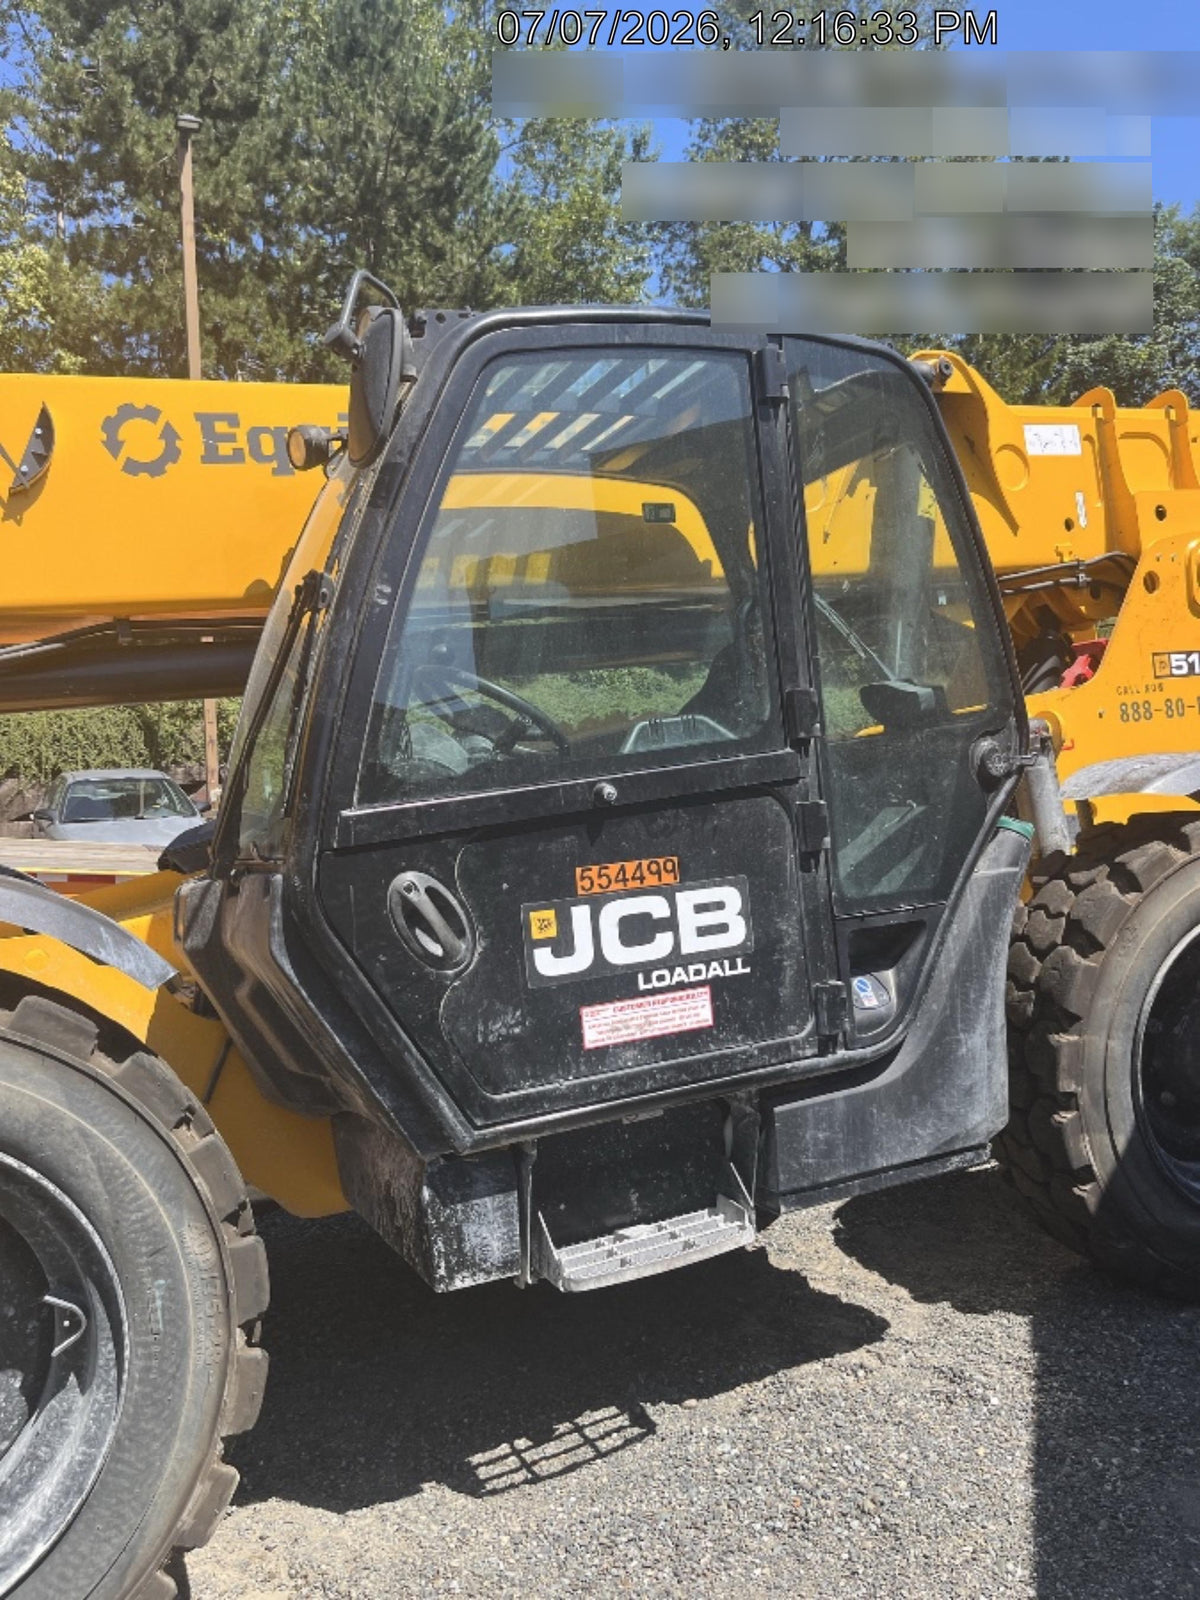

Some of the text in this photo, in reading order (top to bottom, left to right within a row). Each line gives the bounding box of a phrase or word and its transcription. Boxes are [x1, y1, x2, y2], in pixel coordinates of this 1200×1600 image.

[193, 412, 348, 476] Eq
[1120, 696, 1200, 723] 888-80-
[578, 858, 679, 892] 554499
[533, 886, 747, 977] JCB
[637, 957, 751, 991] LOADALL
